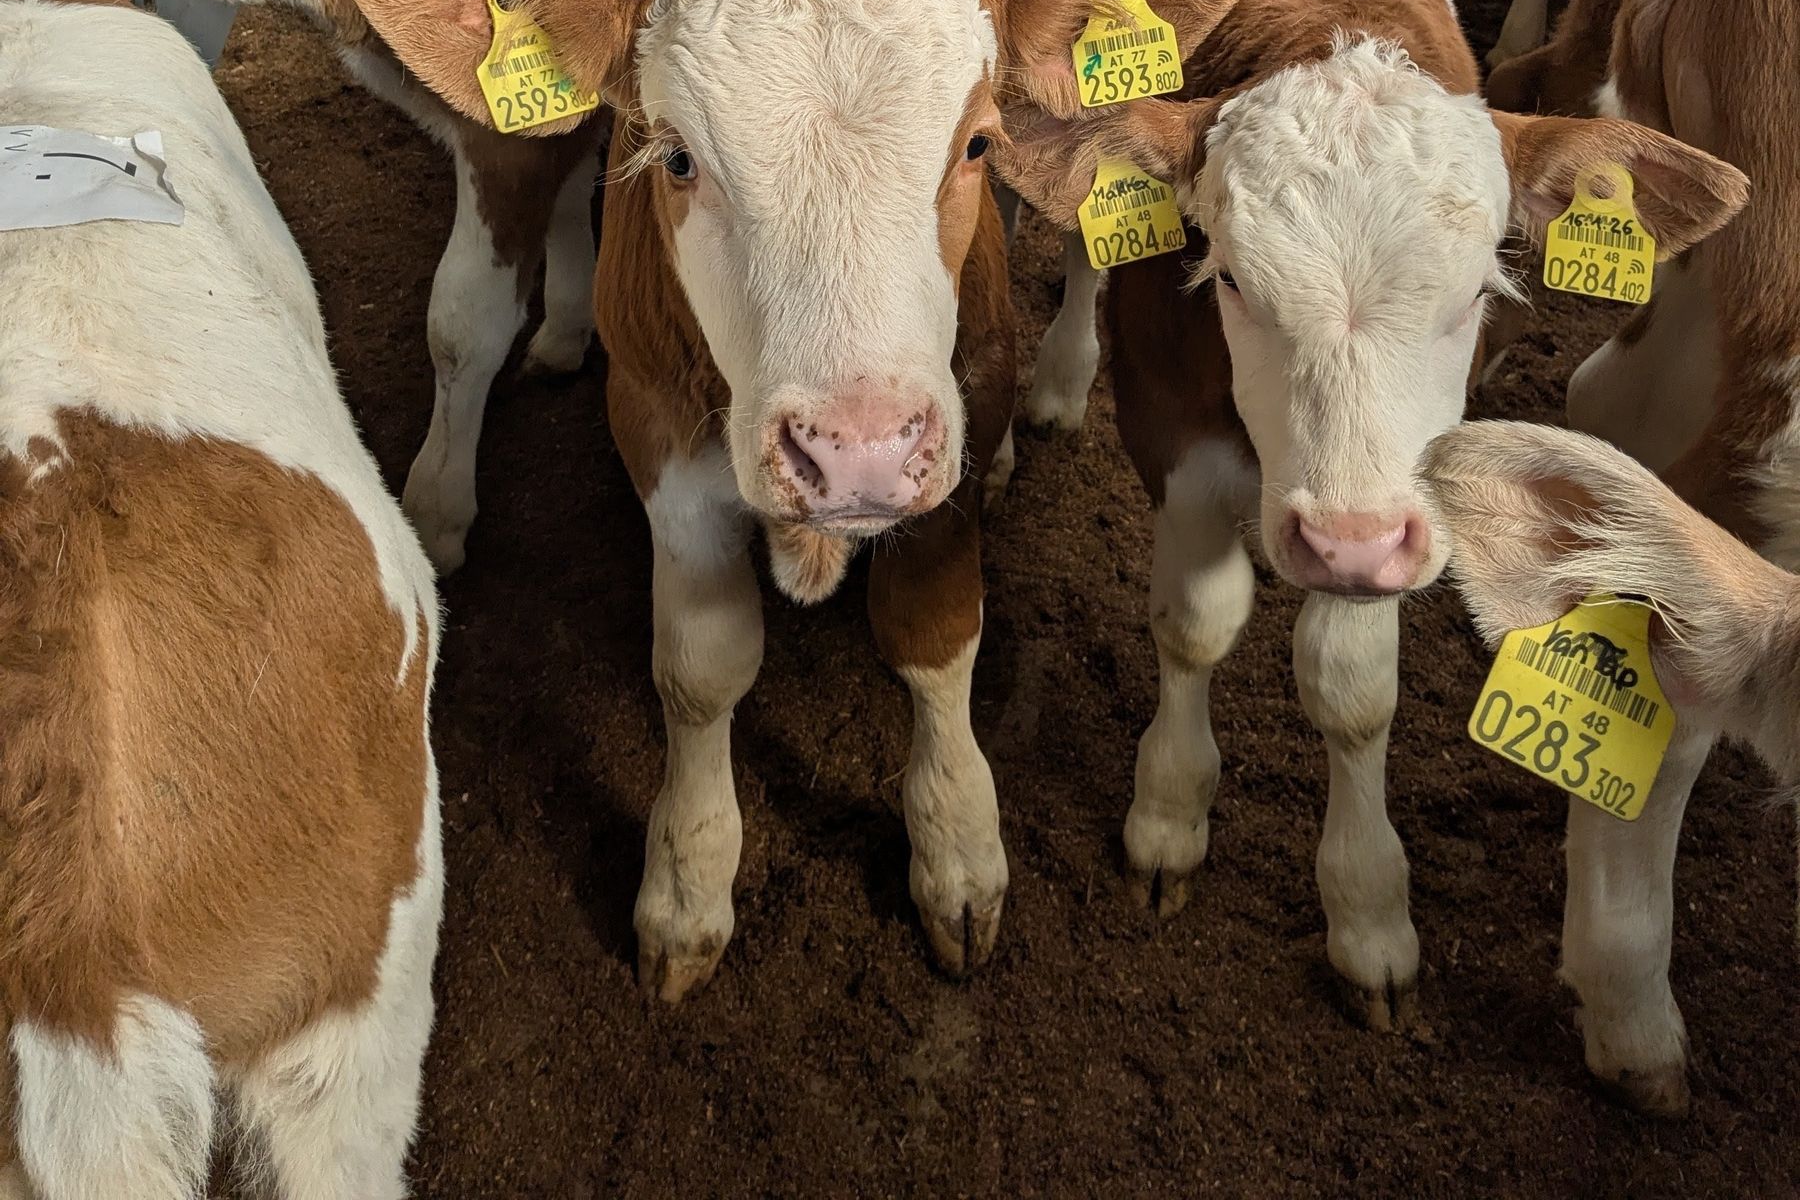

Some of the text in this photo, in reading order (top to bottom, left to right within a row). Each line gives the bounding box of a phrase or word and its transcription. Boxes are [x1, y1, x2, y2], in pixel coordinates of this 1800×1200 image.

[520, 69, 554, 88] AT 77
[1110, 50, 1147, 68] AT 77
[496, 82, 568, 128] 2593
[1085, 63, 1180, 105] 2593 802
[1116, 209, 1152, 229] AT 48
[1092, 222, 1185, 267] 0284 402
[1579, 246, 1621, 264] AT 48
[1547, 256, 1646, 303] 0284 402
[1542, 689, 1611, 736] AT 48
[1475, 689, 1637, 817] 0283 302
